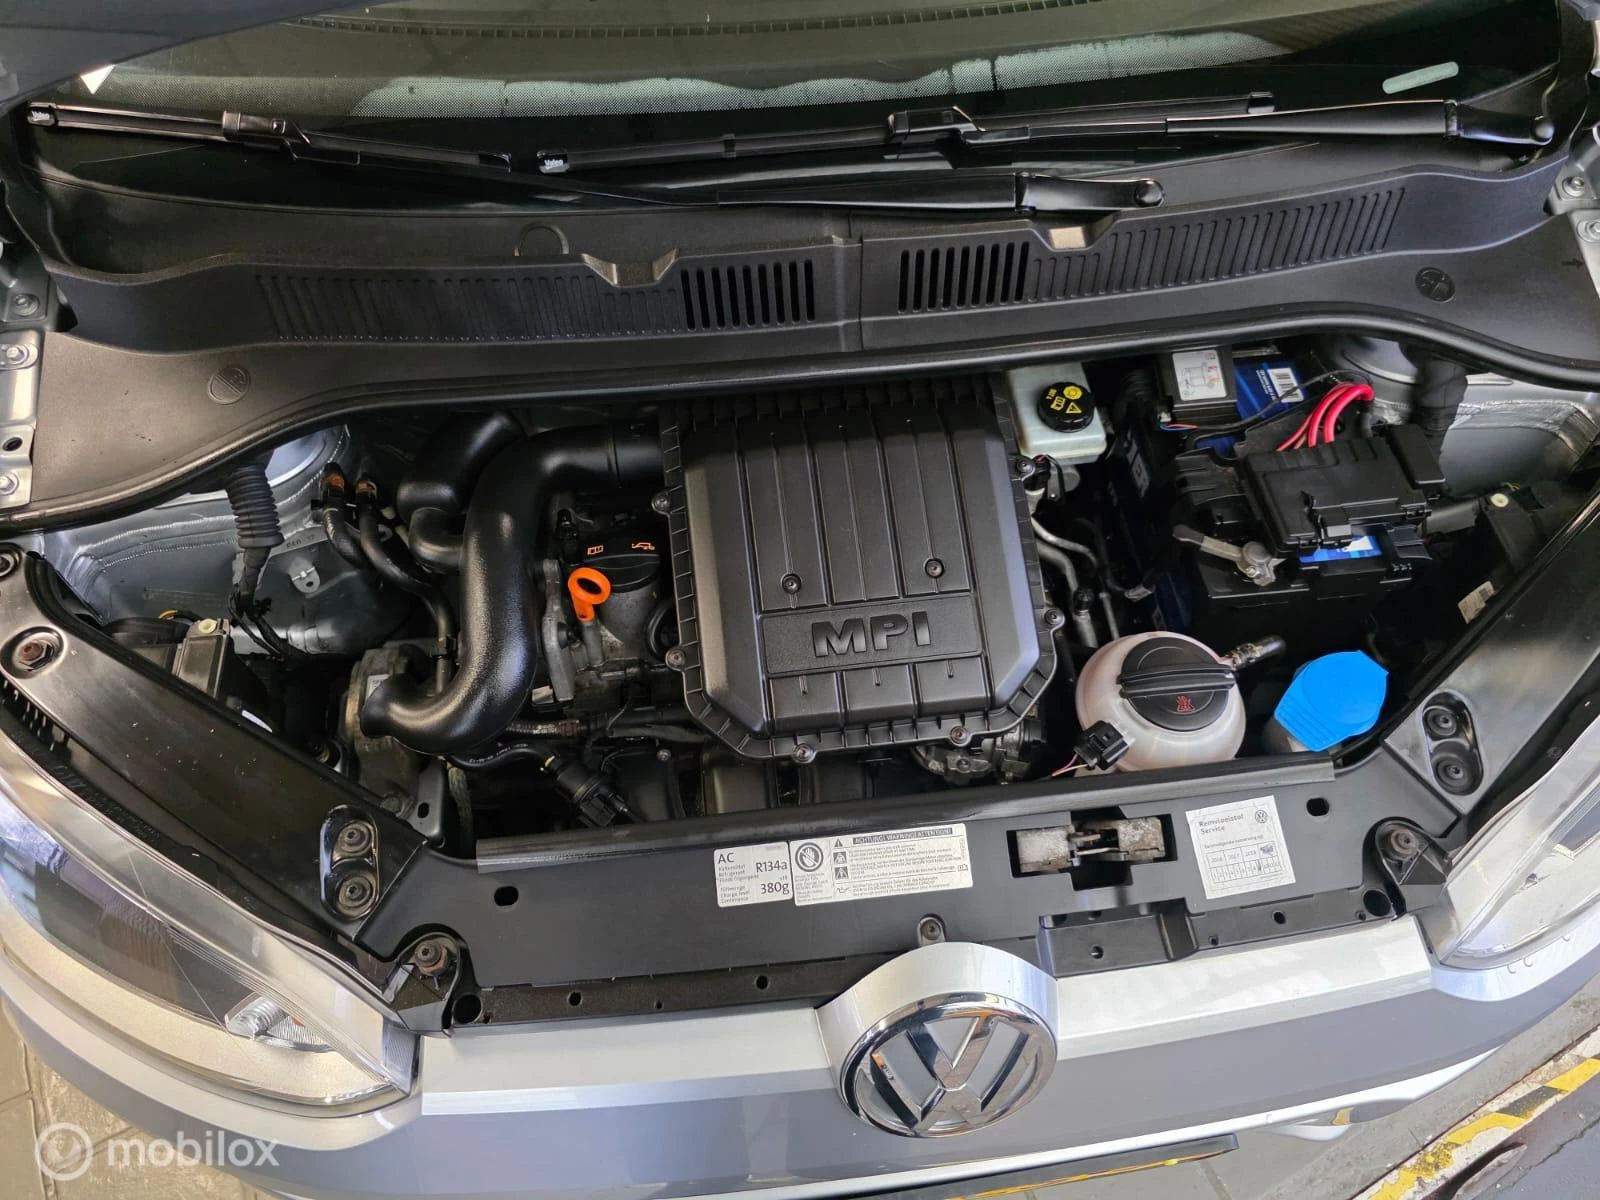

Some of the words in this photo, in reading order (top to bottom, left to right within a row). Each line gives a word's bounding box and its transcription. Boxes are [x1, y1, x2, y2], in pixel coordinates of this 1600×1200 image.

[811, 610, 931, 658] MPI
[717, 852, 734, 864] AC
[755, 860, 788, 873] R134a
[760, 882, 790, 895] 380g
